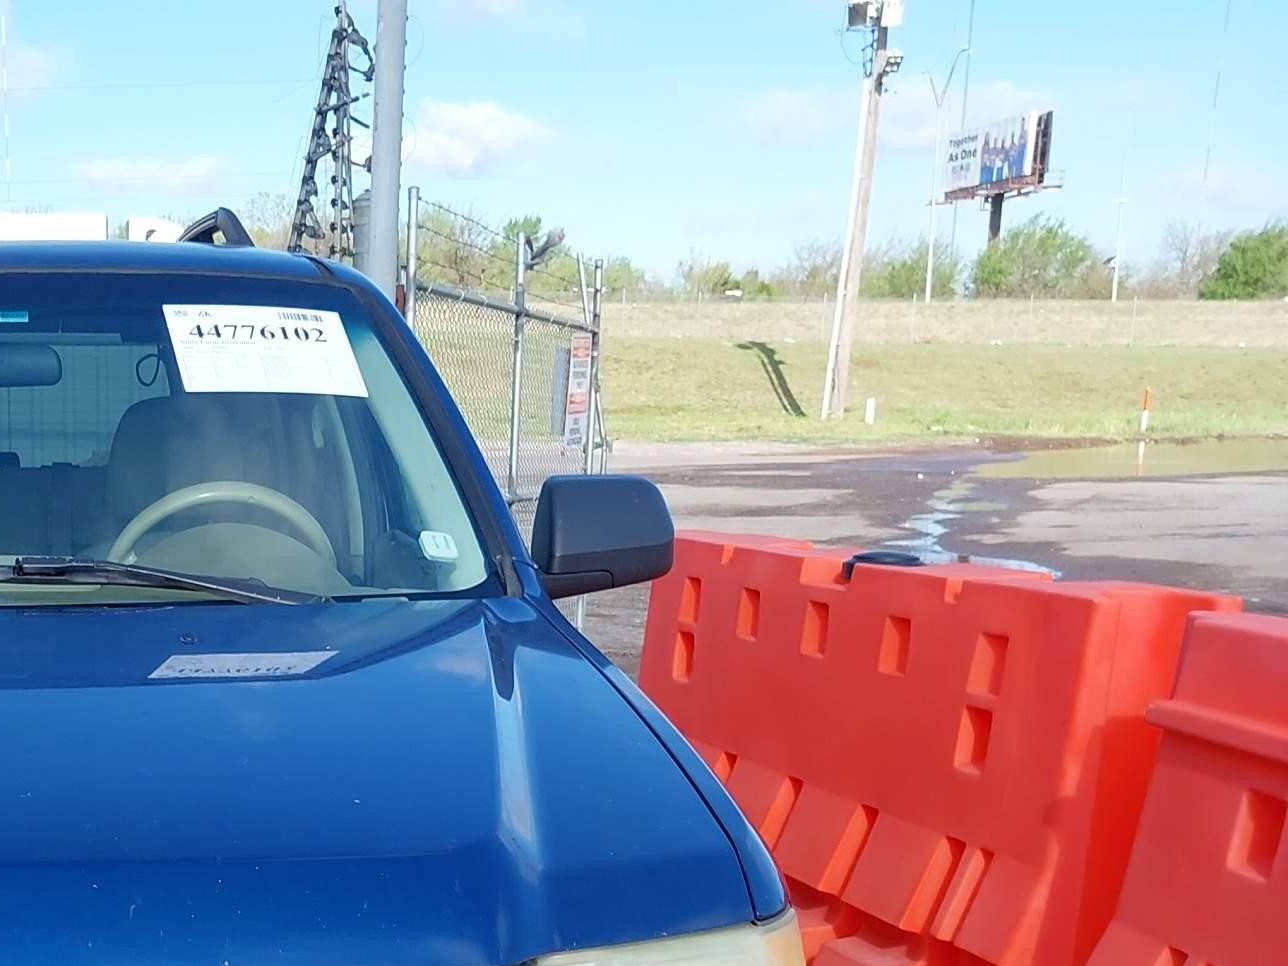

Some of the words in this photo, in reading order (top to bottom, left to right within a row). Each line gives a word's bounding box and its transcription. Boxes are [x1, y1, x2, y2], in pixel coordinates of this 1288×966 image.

[949, 134, 978, 148] Together
[949, 153, 958, 162] As
[961, 149, 977, 160] One
[189, 324, 328, 342] 44776102
